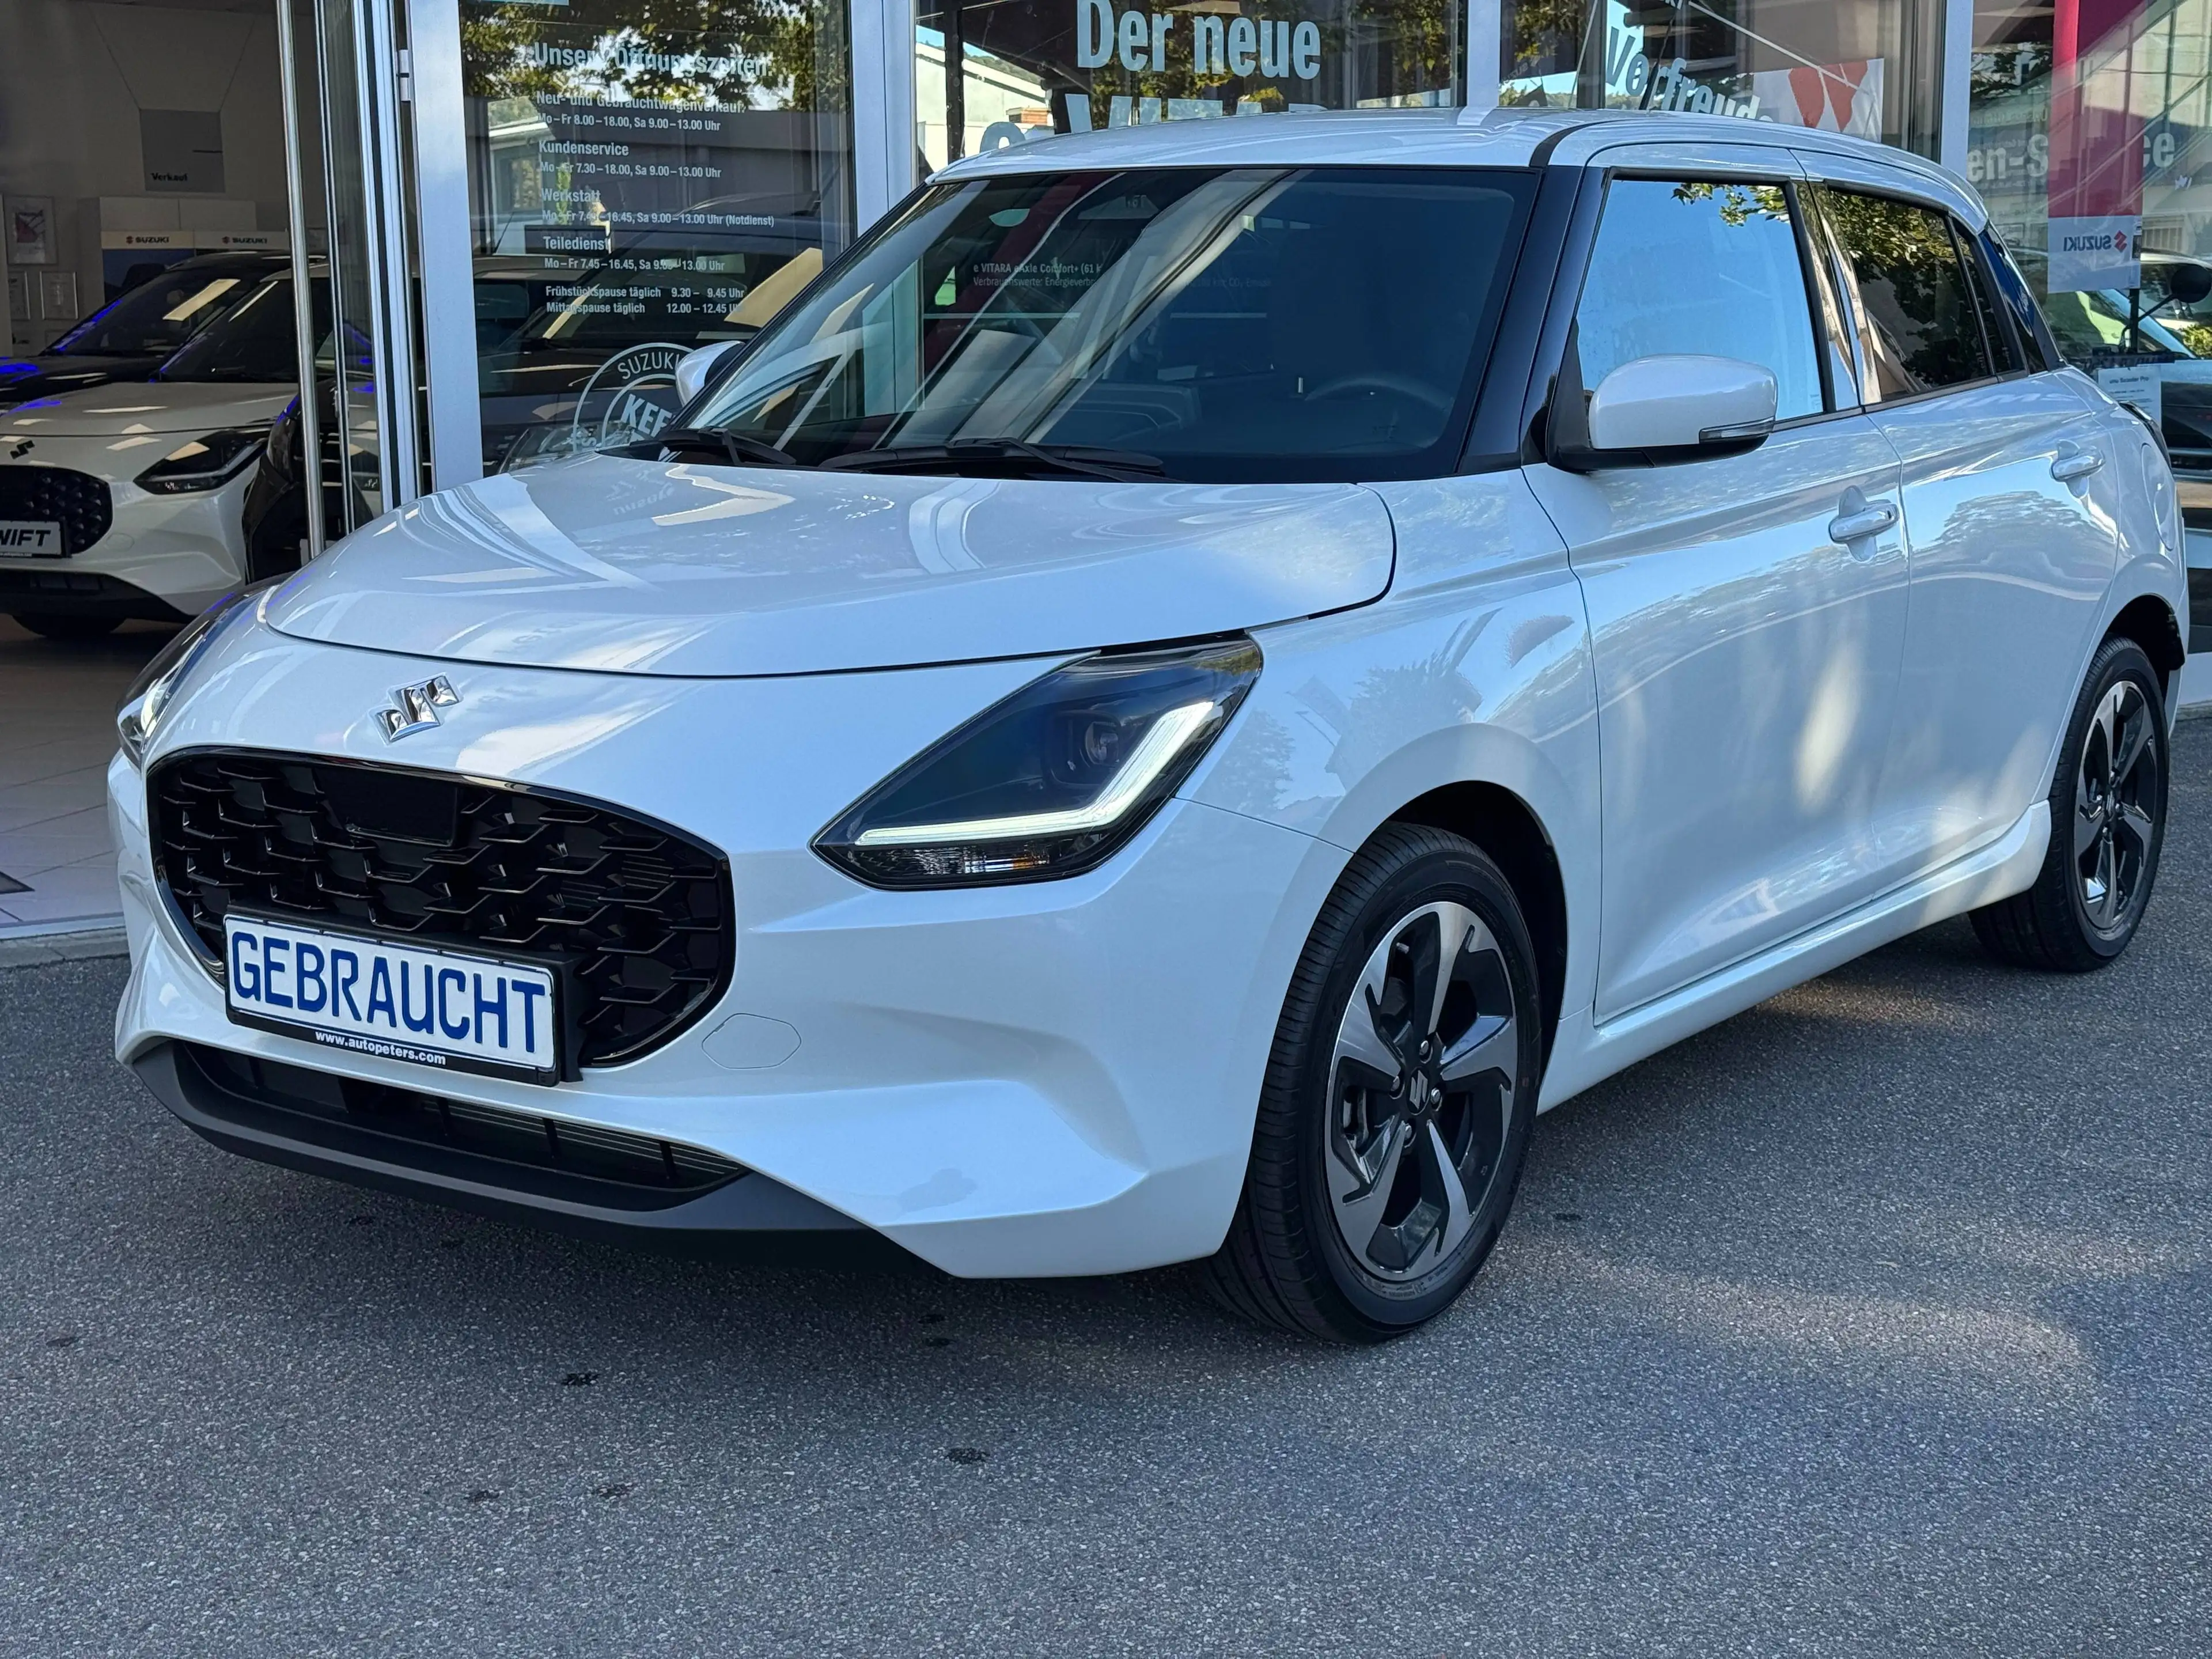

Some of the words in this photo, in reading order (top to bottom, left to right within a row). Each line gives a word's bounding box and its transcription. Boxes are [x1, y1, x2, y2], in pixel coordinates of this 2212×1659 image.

[1077, 0, 1173, 72] Der
[1194, 15, 1321, 80] neue
[570, 93, 593, 106] und
[634, 117, 646, 128] Sa
[705, 120, 721, 131] Uhr
[539, 141, 629, 156] Kundenservice
[635, 164, 647, 176] Sa
[705, 166, 721, 178] Uhr
[541, 188, 601, 202] Werkstatt
[637, 213, 649, 223] Sa
[707, 214, 724, 225] Uhr
[726, 215, 775, 228] (Notdienst)
[543, 236, 610, 251] Teiledienst
[639, 259, 651, 270] Sa
[709, 260, 725, 271] Uhr
[981, 263, 1011, 272] VITARA
[546, 286, 627, 298] Frühstückspause
[629, 287, 661, 299] täglich
[671, 287, 691, 298] 9.30
[707, 288, 726, 298] 9.45
[729, 289, 745, 298] Uhr
[547, 302, 611, 315] Mittagspause
[613, 303, 645, 315] täglich
[618, 351, 680, 380] SUZUKI
[232, 931, 545, 1053] GEBRAUCHT
[315, 1031, 446, 1066] www.autopeters.com
